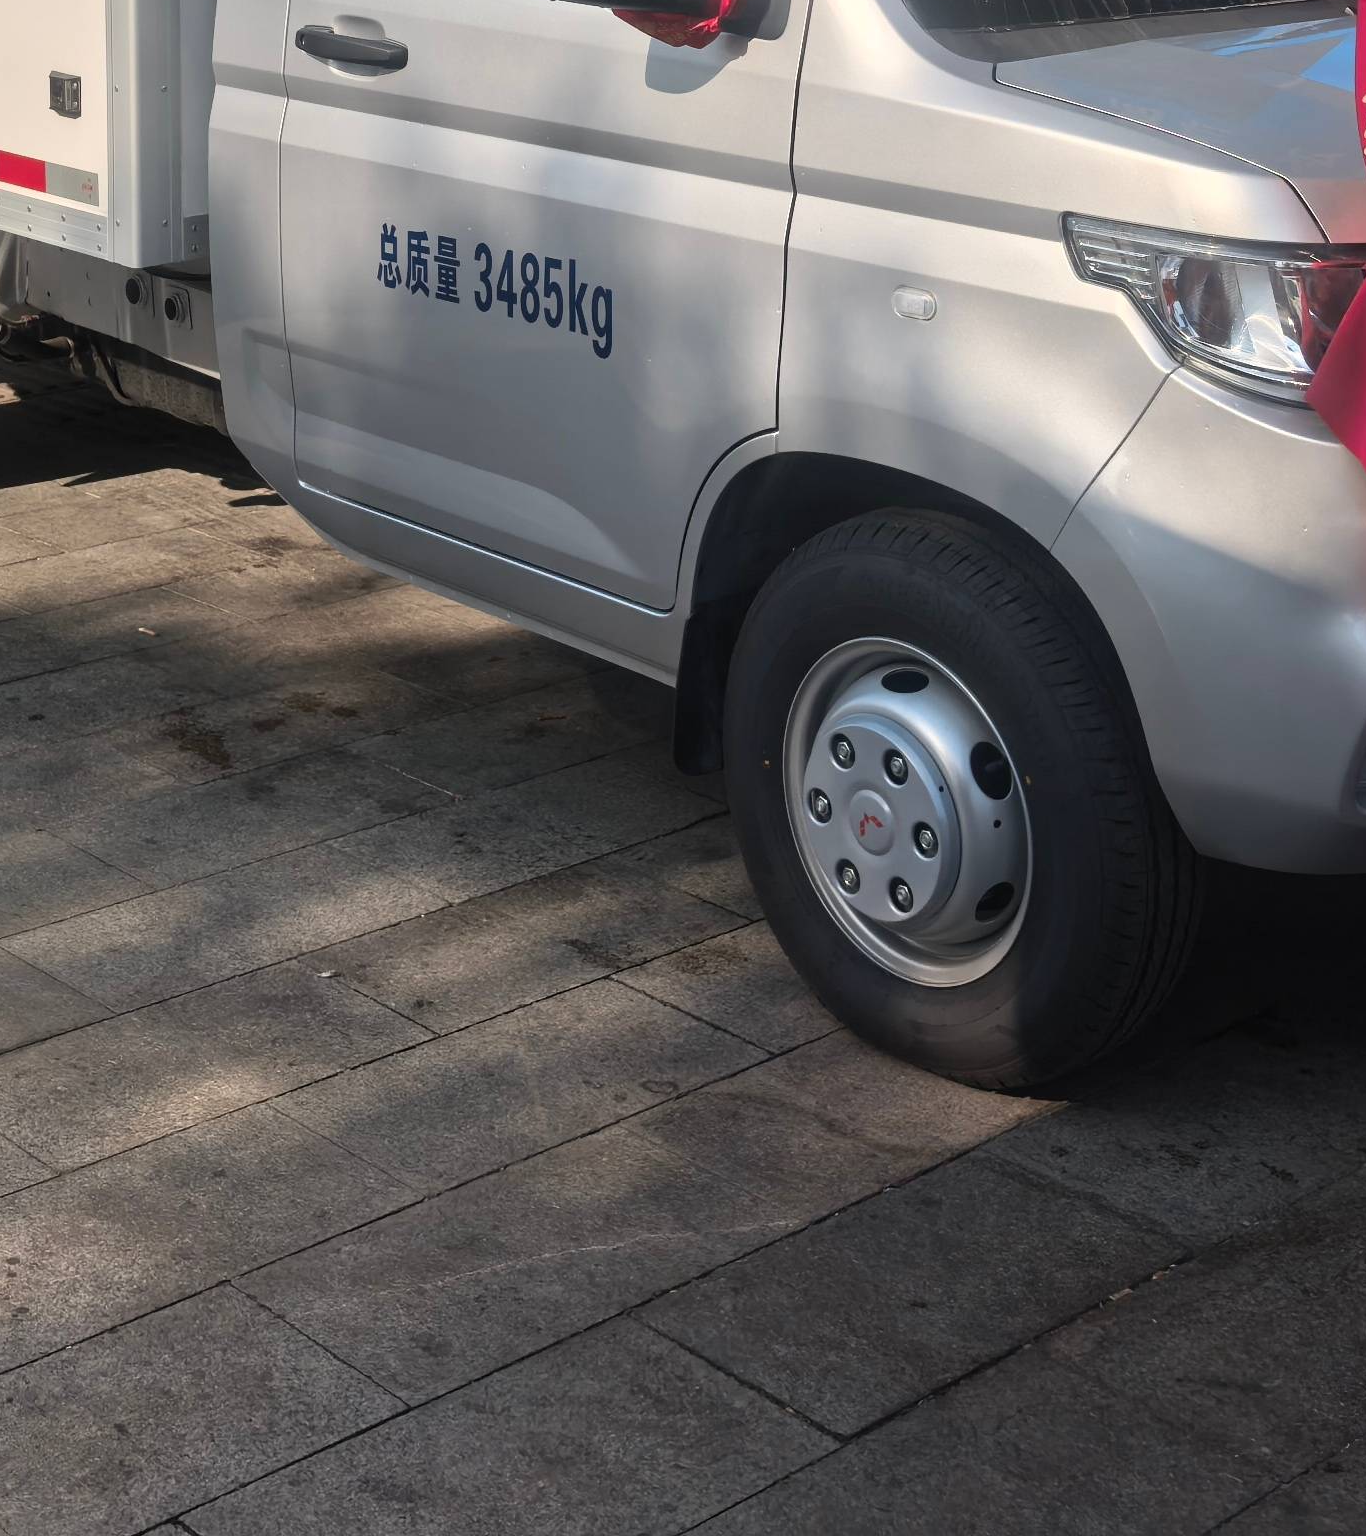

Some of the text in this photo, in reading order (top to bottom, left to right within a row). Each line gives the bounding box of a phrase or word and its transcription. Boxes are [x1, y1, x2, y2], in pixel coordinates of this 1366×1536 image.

[377, 223, 614, 359] 总质量 3485kg
